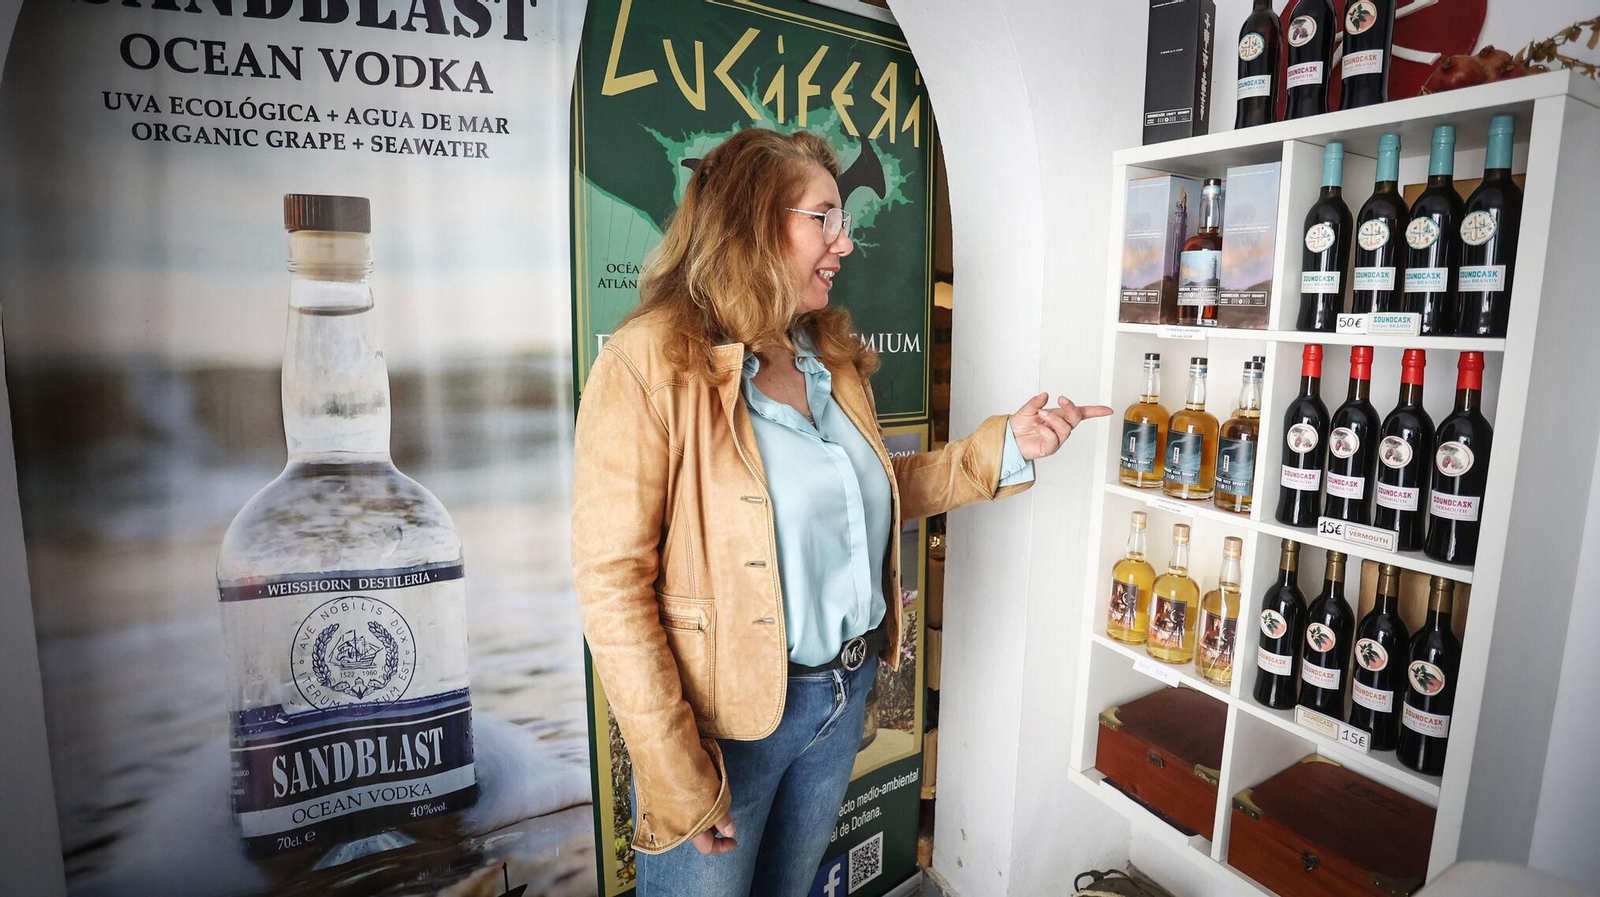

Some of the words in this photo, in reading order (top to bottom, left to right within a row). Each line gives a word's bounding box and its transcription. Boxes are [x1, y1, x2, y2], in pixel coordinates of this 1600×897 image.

[120, 33, 304, 81] OCEAN
[318, 47, 494, 95] VODKA
[102, 91, 162, 114] UVA
[168, 96, 321, 122] ECOLÓGICA
[326, 109, 339, 122] +
[344, 107, 415, 129] AGUA
[421, 112, 452, 131] DE
[458, 115, 510, 134] MAR
[131, 122, 259, 147] ORGANIC
[265, 130, 346, 150] GRAPE
[352, 138, 365, 150] +
[371, 135, 490, 159] SEAWATER
[606, 261, 647, 274] OCÉA
[597, 277, 640, 289] ATLÁN
[1339, 317, 1363, 328] 50€
[1373, 316, 1412, 324] SOUNDCASK
[849, 333, 921, 353] MIUM
[1378, 487, 1413, 499] SOUNDCASK
[1433, 496, 1473, 508] SOUNDCASK
[1320, 521, 1342, 535] 15€
[1349, 531, 1389, 544] VERMOUTH
[267, 579, 351, 596] WEISSHORN
[358, 572, 430, 590] DESTILERIA
[320, 601, 384, 621] NOBILIS
[390, 619, 409, 643] DUX
[398, 661, 411, 681] EST
[1406, 708, 1444, 726] SOUNDCASK
[1342, 730, 1365, 748] 15€
[272, 726, 444, 798] SANDBLAST
[838, 800, 855, 817] ecto
[857, 767, 919, 807] medio-ambiental
[292, 793, 362, 824] OCEAN
[367, 782, 433, 804] VODKA
[830, 827, 838, 842] al
[840, 822, 850, 837] de
[852, 806, 882, 831] Doñana.
